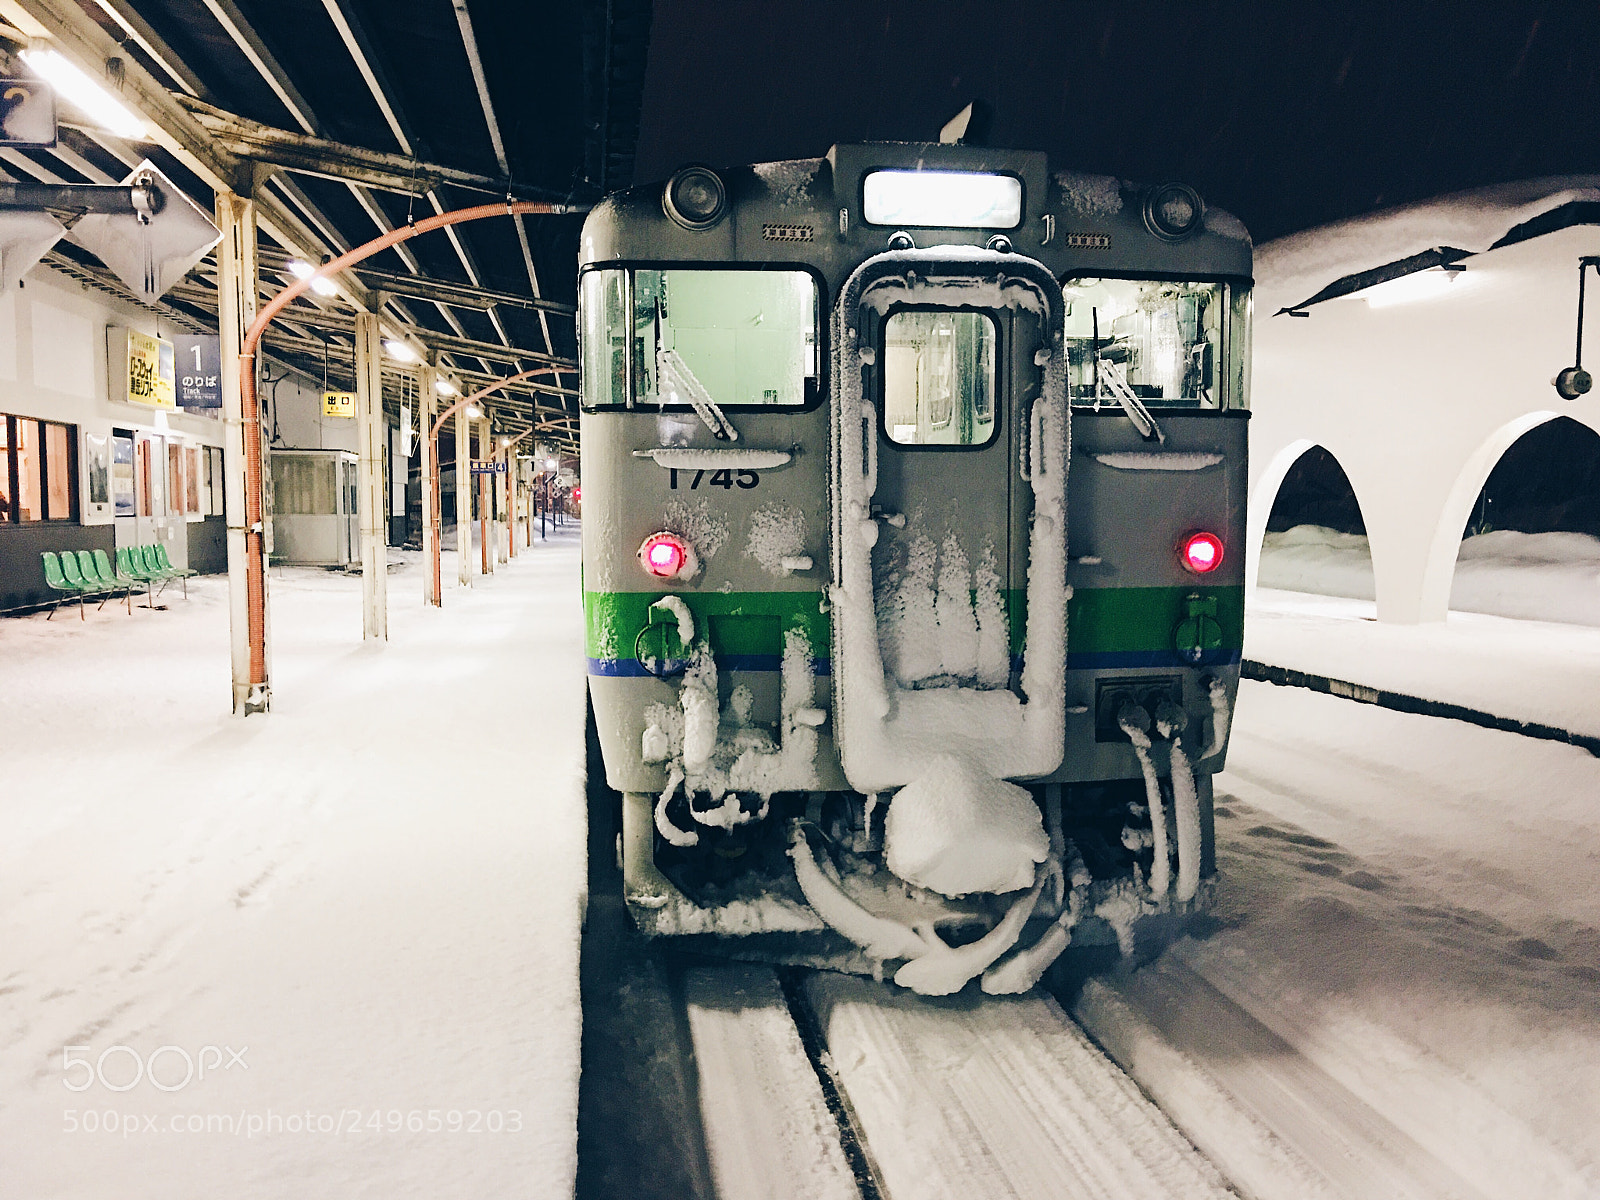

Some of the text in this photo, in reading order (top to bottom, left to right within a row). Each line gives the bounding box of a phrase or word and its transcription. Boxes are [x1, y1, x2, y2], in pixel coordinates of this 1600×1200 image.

[190, 344, 202, 372] 1
[182, 376, 217, 387] のりば
[327, 395, 350, 405] 出口
[669, 467, 760, 490] 1745
